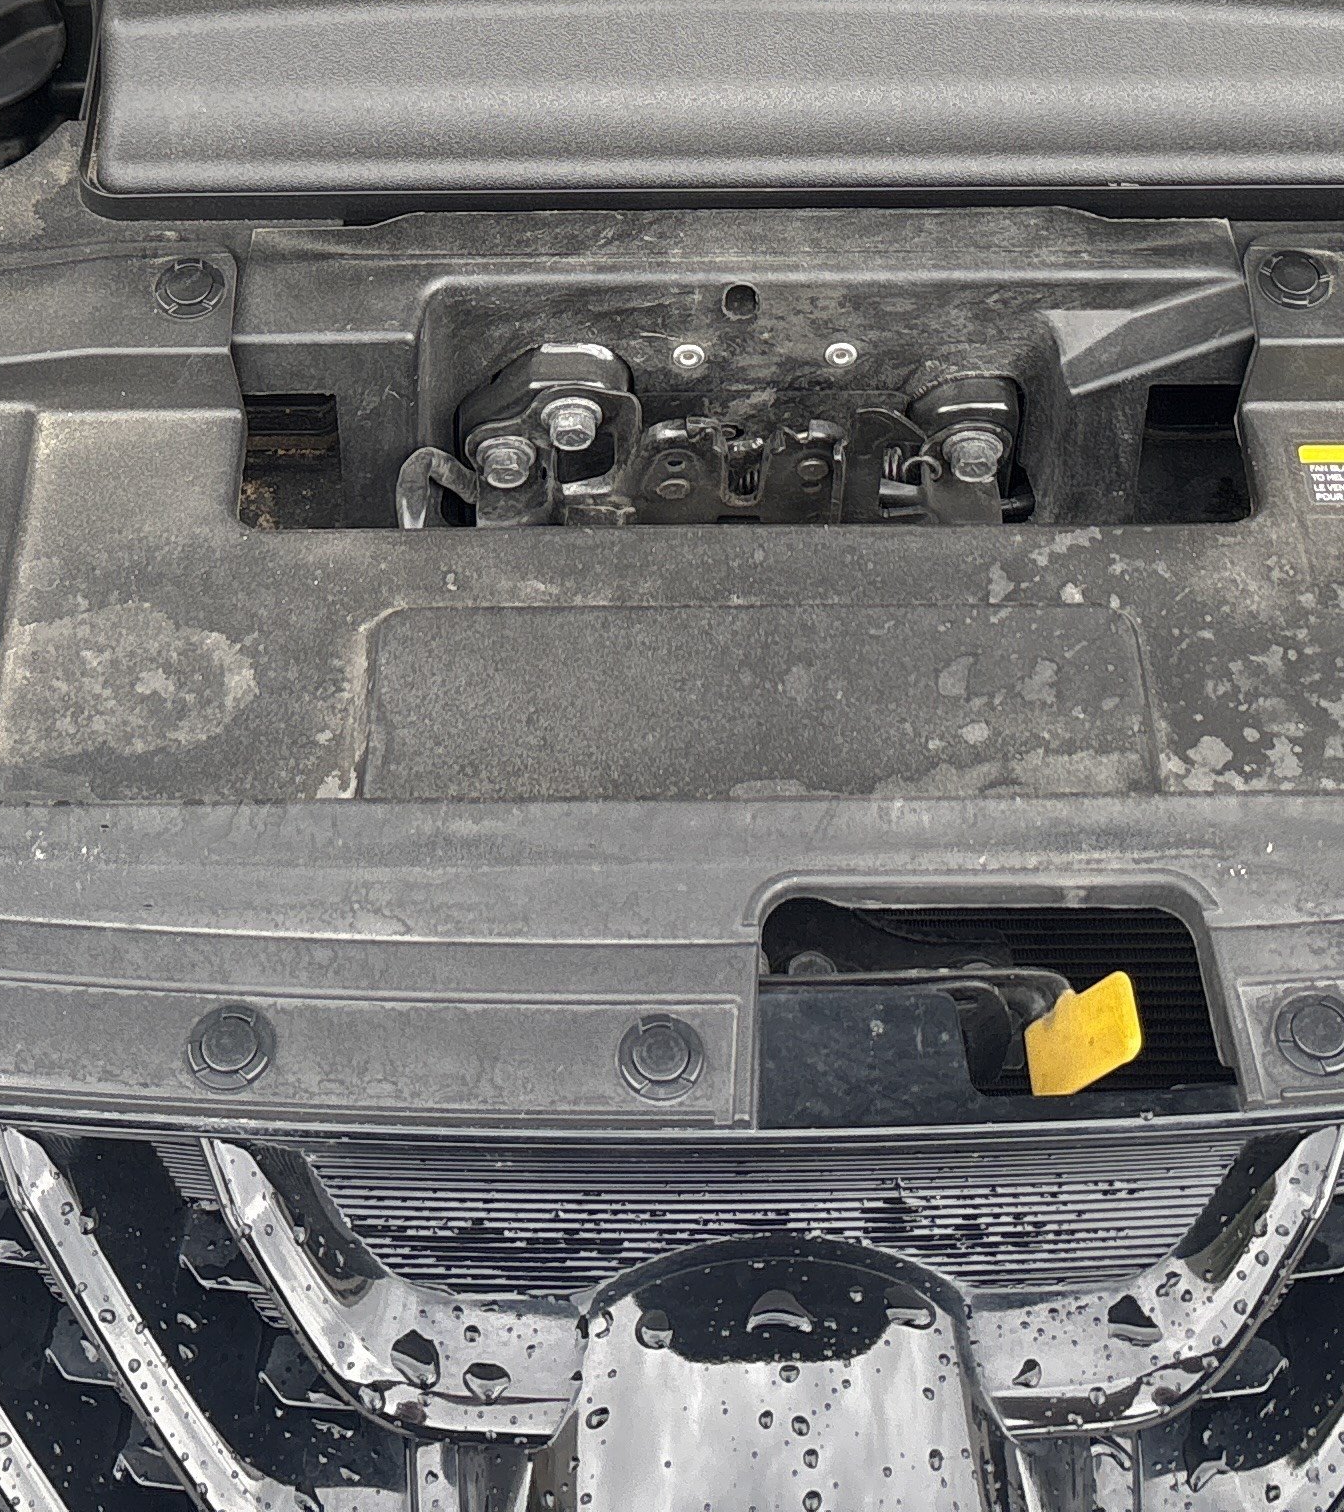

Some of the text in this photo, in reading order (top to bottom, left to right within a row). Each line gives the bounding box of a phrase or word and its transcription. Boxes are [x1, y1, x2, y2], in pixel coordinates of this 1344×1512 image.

[1311, 473, 1326, 482] TO
[1314, 483, 1327, 492] LE
[1315, 492, 1344, 501] POUR
